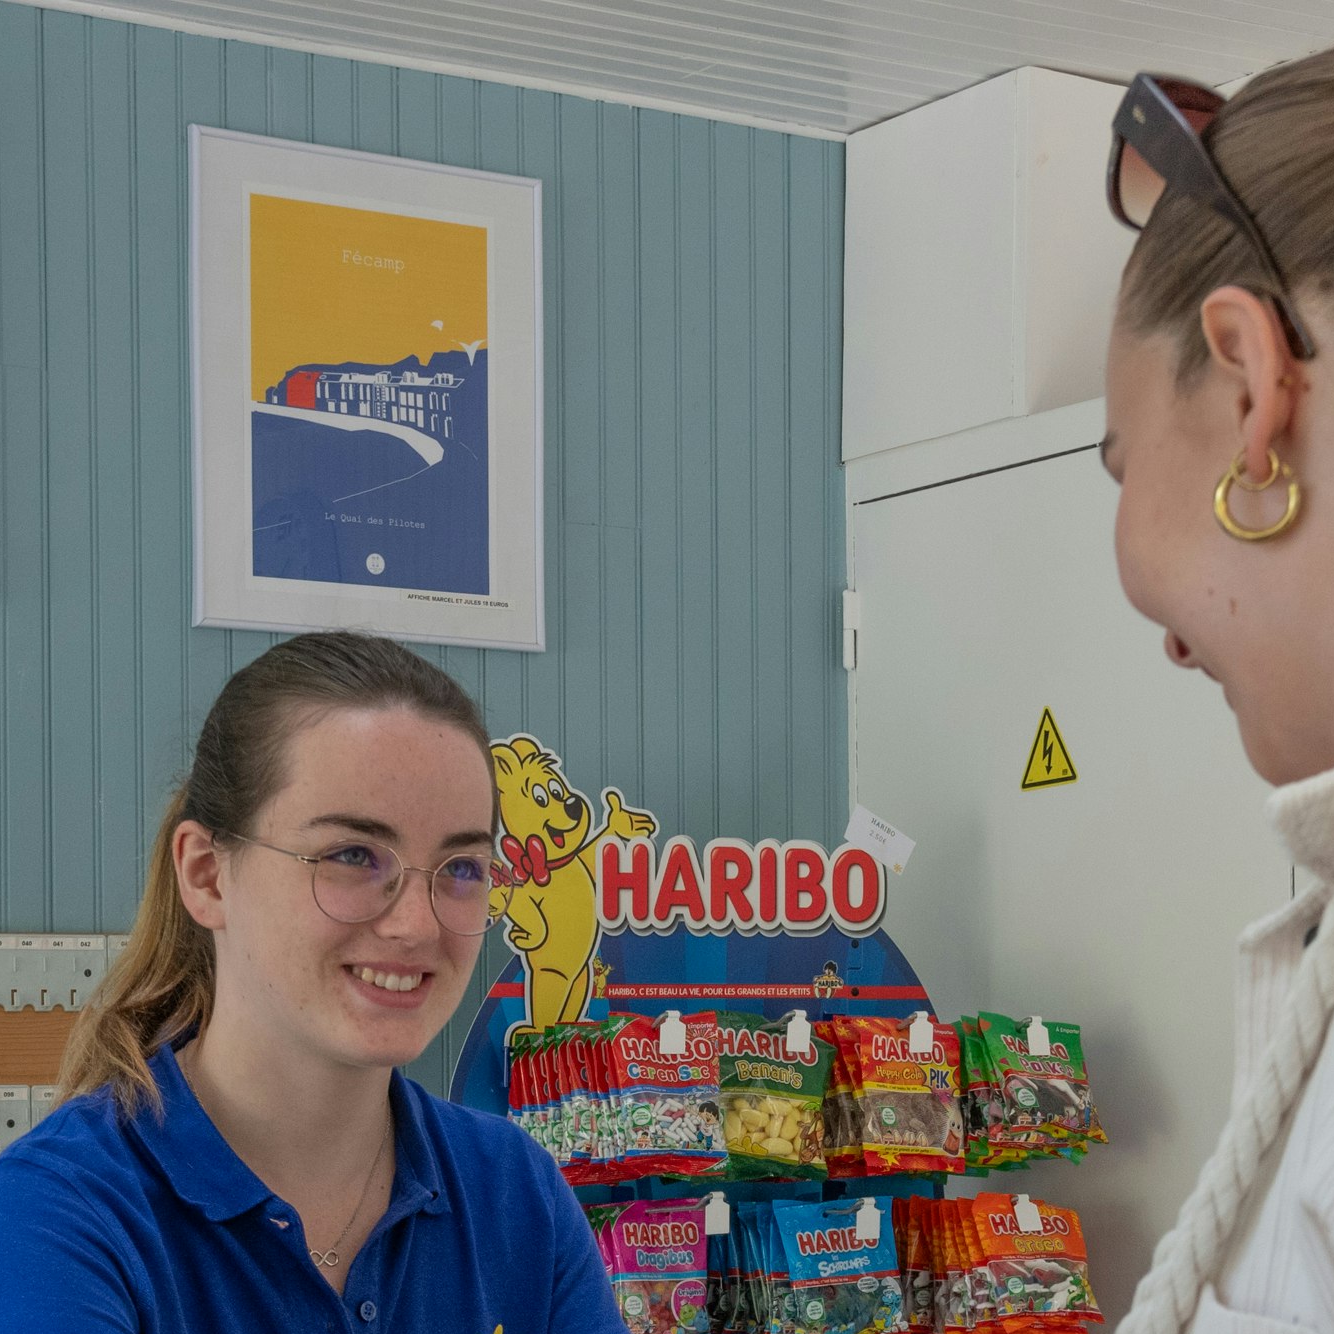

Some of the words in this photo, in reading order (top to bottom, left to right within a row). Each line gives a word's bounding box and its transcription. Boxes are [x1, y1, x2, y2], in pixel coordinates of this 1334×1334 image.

[325, 512, 336, 521] Le
[340, 514, 362, 524] Quai
[367, 516, 384, 525] des
[388, 518, 425, 529] Pilotes
[407, 593, 431, 602] AFFICHE
[431, 596, 455, 604] MARCEL
[601, 842, 880, 922] HARIBO
[21, 940, 33, 948] 040
[52, 941, 64, 949] 041
[80, 941, 91, 949] 042
[608, 987, 638, 997] HARIBO,
[658, 987, 678, 997] BEAU
[679, 987, 688, 997] LA
[688, 987, 702, 998] VIE,
[703, 987, 724, 997] POUR
[724, 987, 736, 997] LES
[736, 987, 766, 997] GRANDS
[767, 987, 776, 997] ET
[776, 987, 788, 997] LES
[789, 987, 811, 997] PETITS
[872, 1034, 945, 1066] HARO
[627, 1062, 656, 1079] Car
[656, 1069, 678, 1083] en
[678, 1064, 710, 1082] Sac
[735, 1059, 803, 1089] Banan's
[876, 1065, 900, 1080] Happy
[903, 1067, 923, 1081] Cola
[622, 1221, 699, 1247] HARIBO
[988, 1213, 1069, 1236] HABO
[636, 1248, 694, 1270] Dragibus
